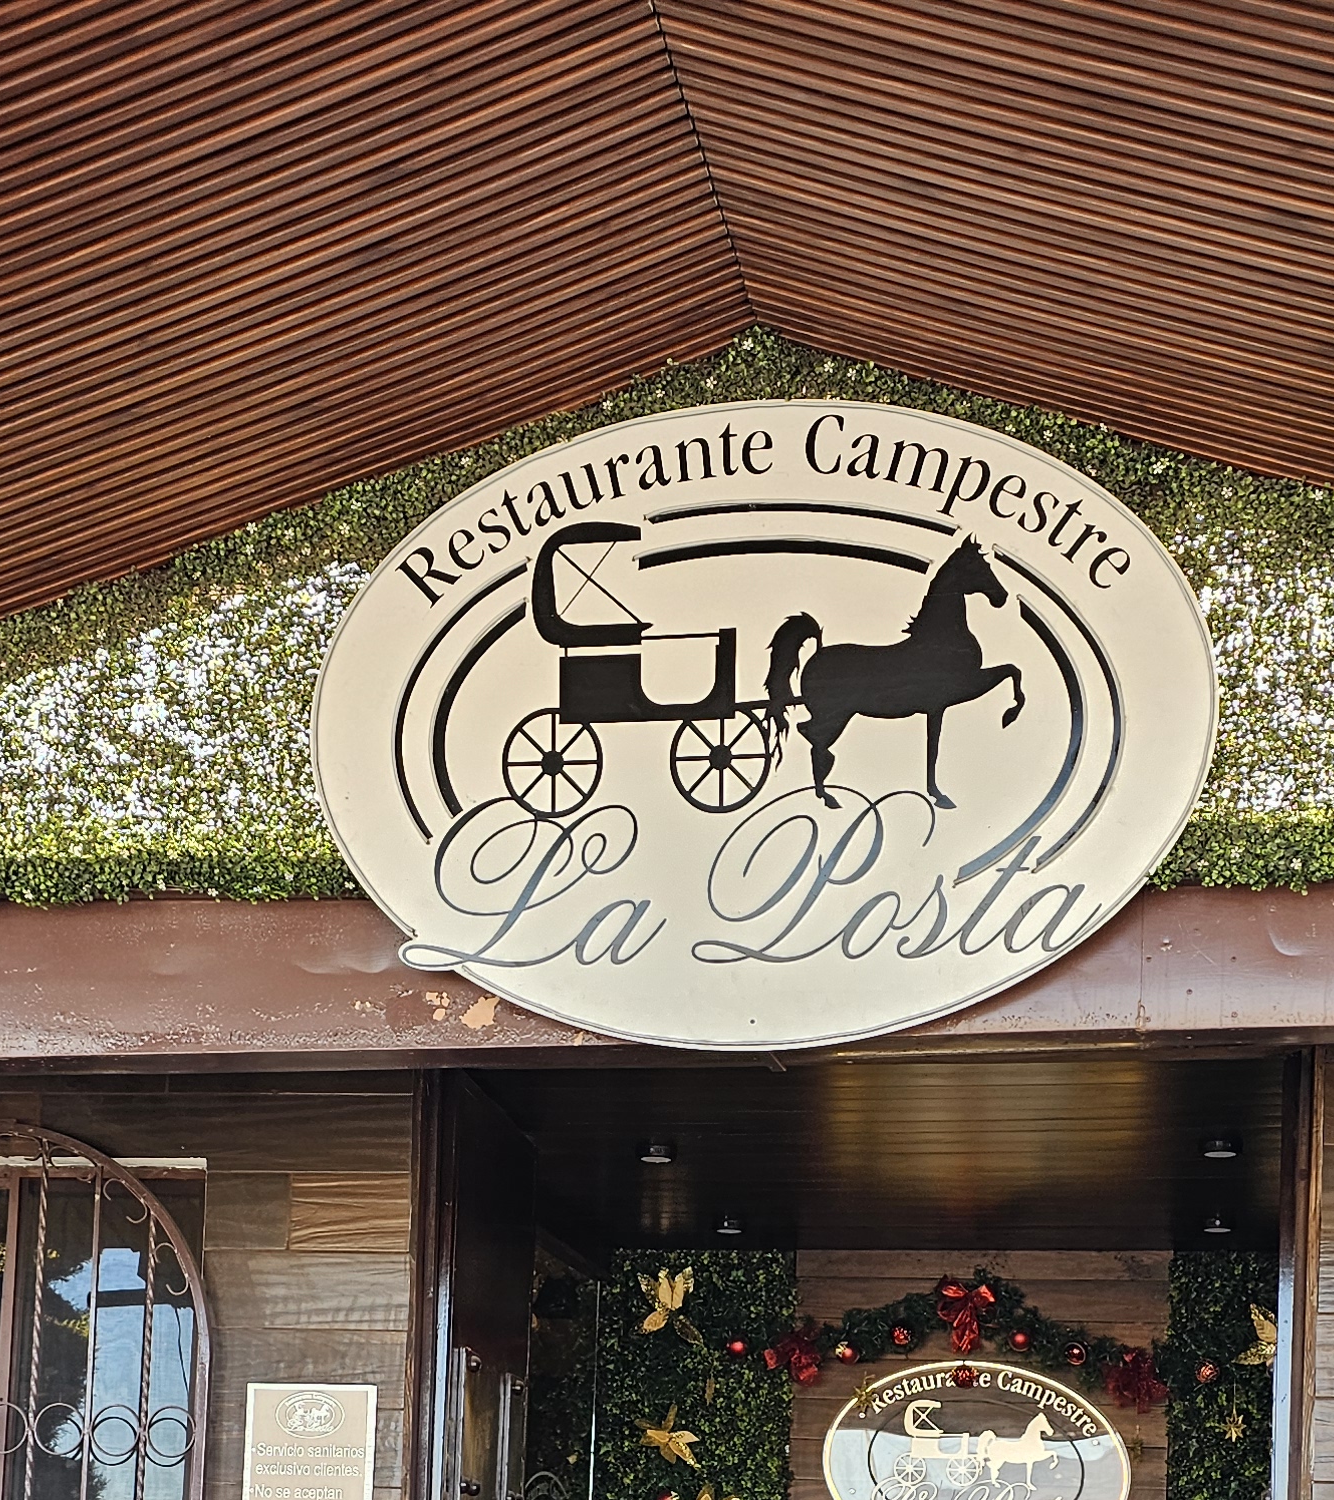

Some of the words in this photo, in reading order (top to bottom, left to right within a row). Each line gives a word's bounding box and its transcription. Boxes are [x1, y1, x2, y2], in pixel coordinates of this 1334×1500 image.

[396, 421, 775, 605] Restaurante
[804, 413, 1134, 591] Campestre
[399, 795, 667, 970] La
[691, 785, 1103, 965] Posta
[871, 1371, 991, 1414] Restaurae
[997, 1369, 1099, 1437] Campestre
[255, 1463, 310, 1476] exclusivo
[256, 1442, 304, 1457] Servicio
[307, 1444, 365, 1458] sanitarios
[254, 1485, 272, 1498] No
[275, 1487, 290, 1498] se
